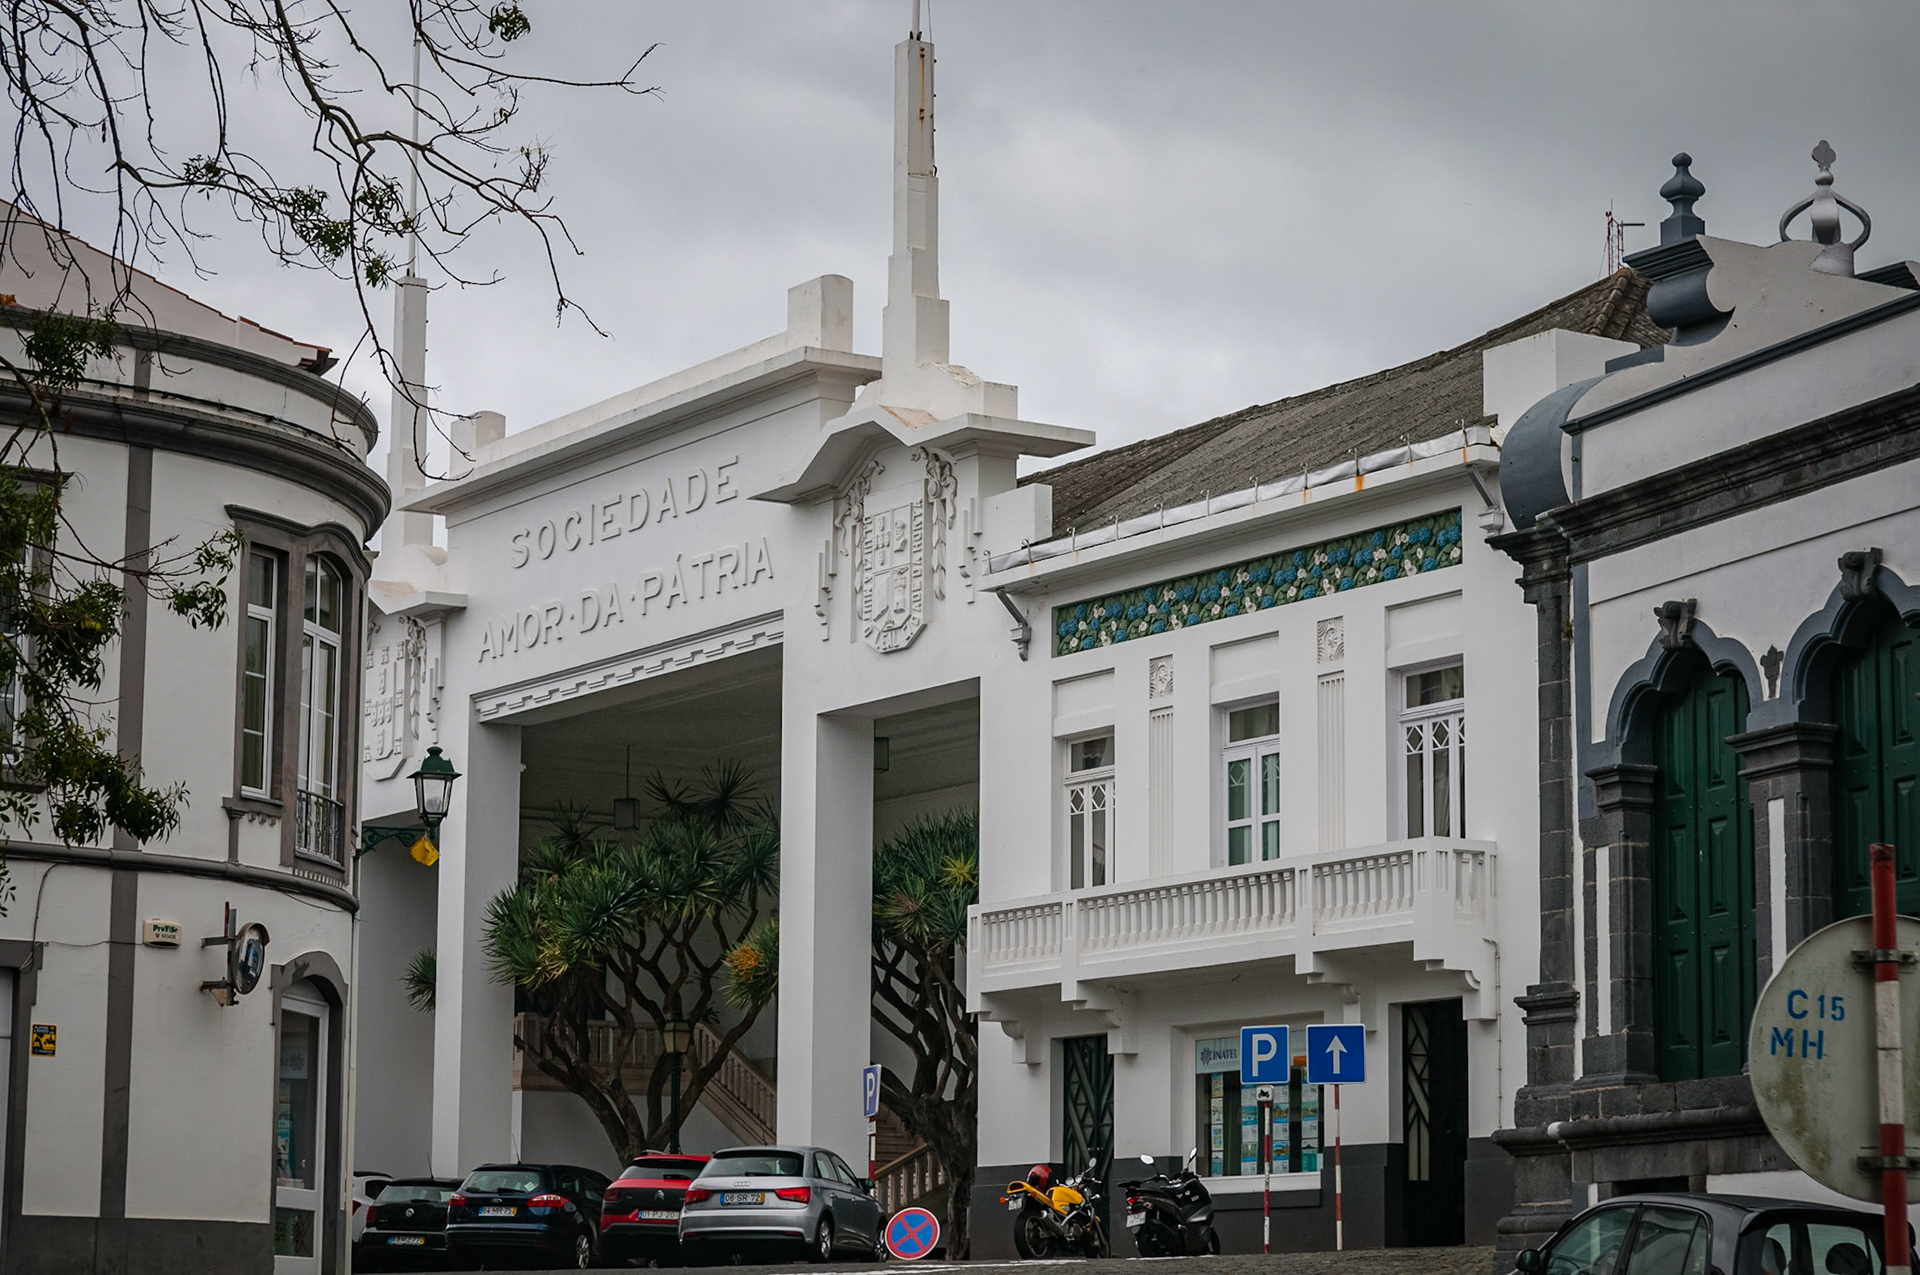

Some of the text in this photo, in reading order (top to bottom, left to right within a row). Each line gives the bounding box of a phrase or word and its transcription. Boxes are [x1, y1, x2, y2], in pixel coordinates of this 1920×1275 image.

[511, 455, 739, 569] SOCIEDADE
[912, 499, 923, 553] HORTA
[642, 536, 774, 617] PÁTRIA
[1213, 1049, 1238, 1060] INATEL
[1252, 1033, 1277, 1077] P
[1770, 1027, 1824, 1060] MH
[866, 1072, 876, 1111] P
